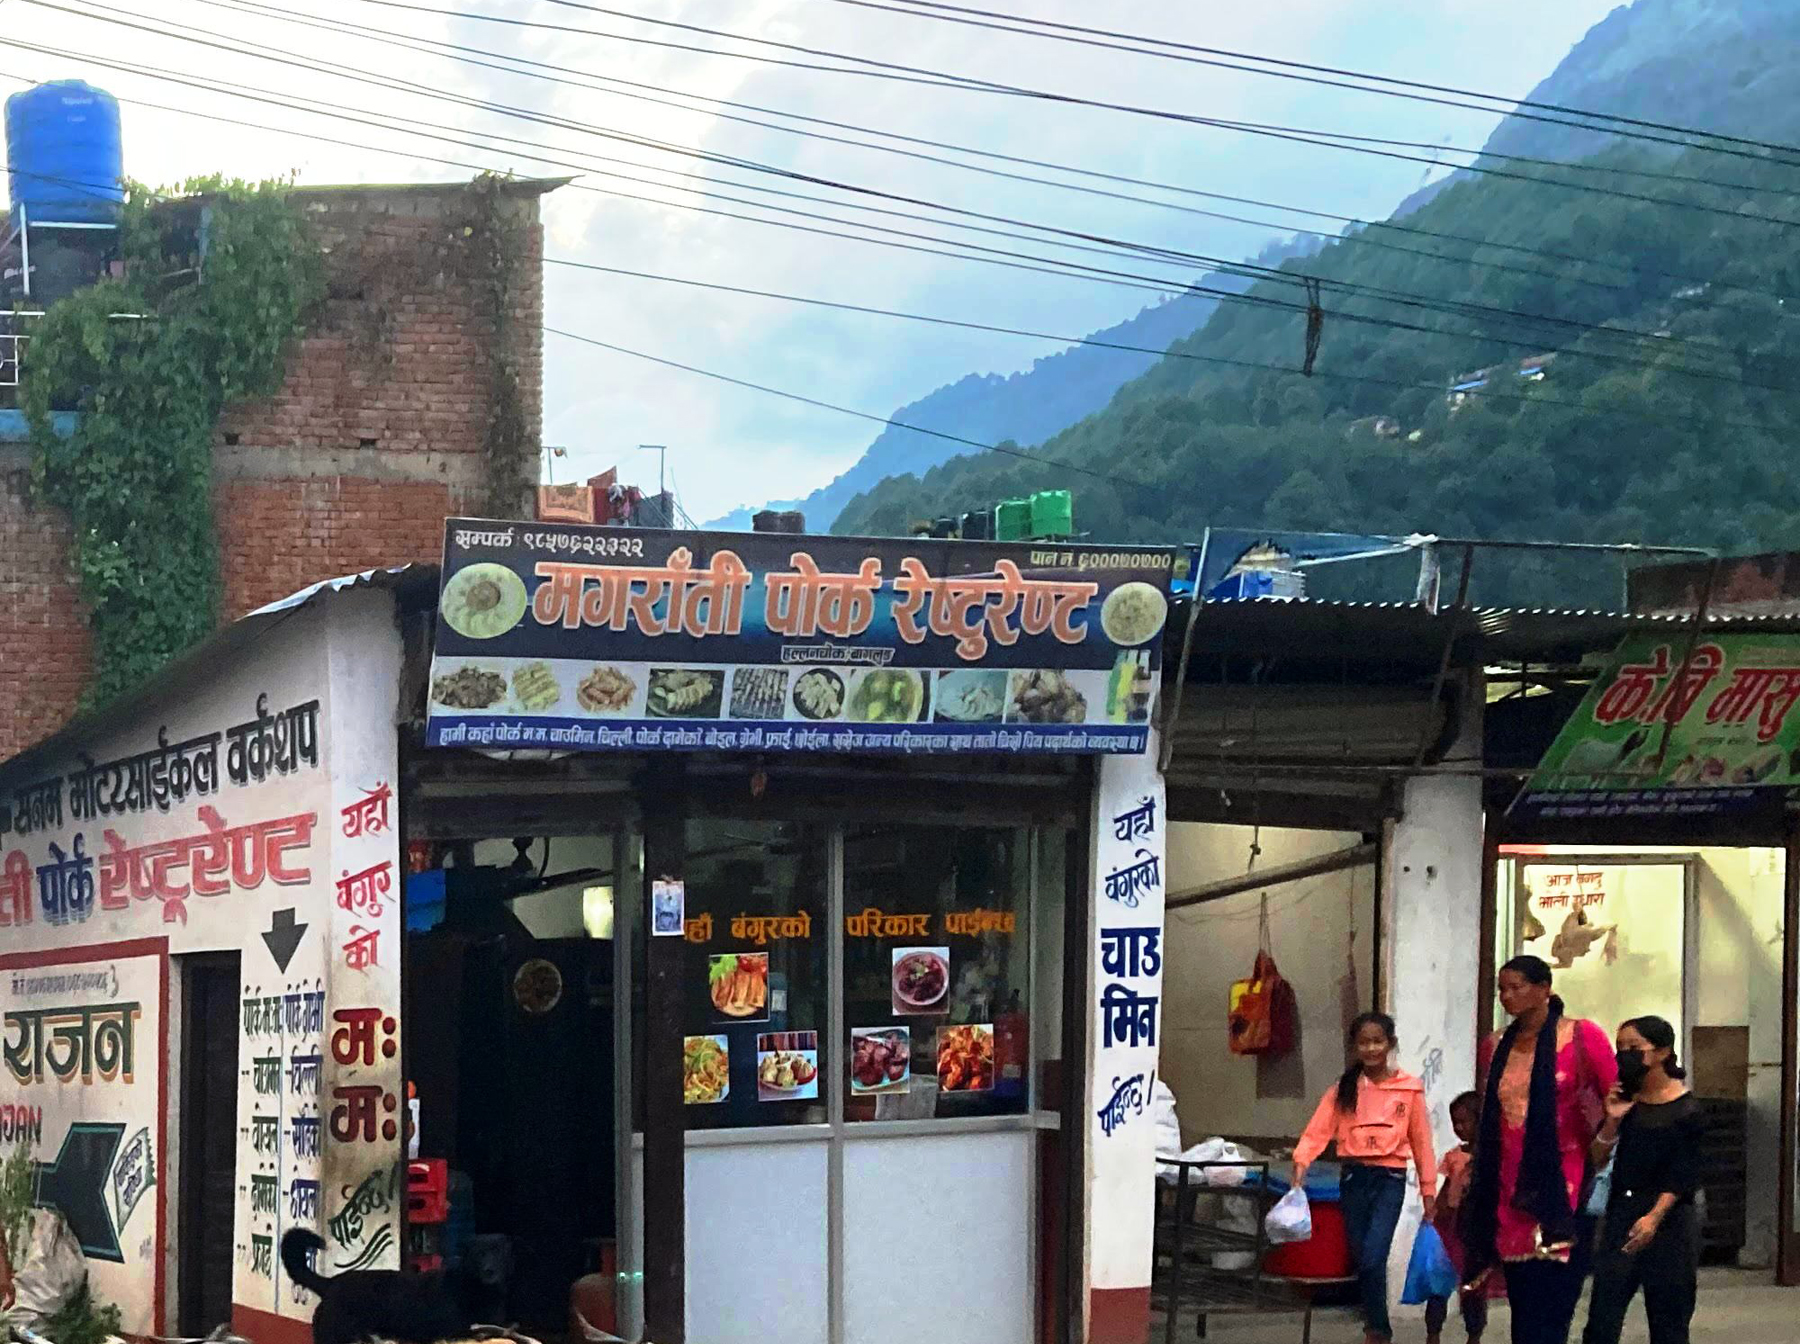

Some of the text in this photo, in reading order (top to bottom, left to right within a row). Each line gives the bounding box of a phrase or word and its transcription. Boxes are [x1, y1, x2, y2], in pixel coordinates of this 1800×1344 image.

[532, 546, 752, 638] मगराँती
[764, 552, 882, 639] पोर्क
[439, 721, 466, 746] हामी
[36, 832, 96, 928] पोर्क
[343, 923, 381, 971] को
[1101, 926, 1160, 979] चाउ
[2, 1001, 142, 1087] राजन
[1100, 983, 1159, 1049] मिन
